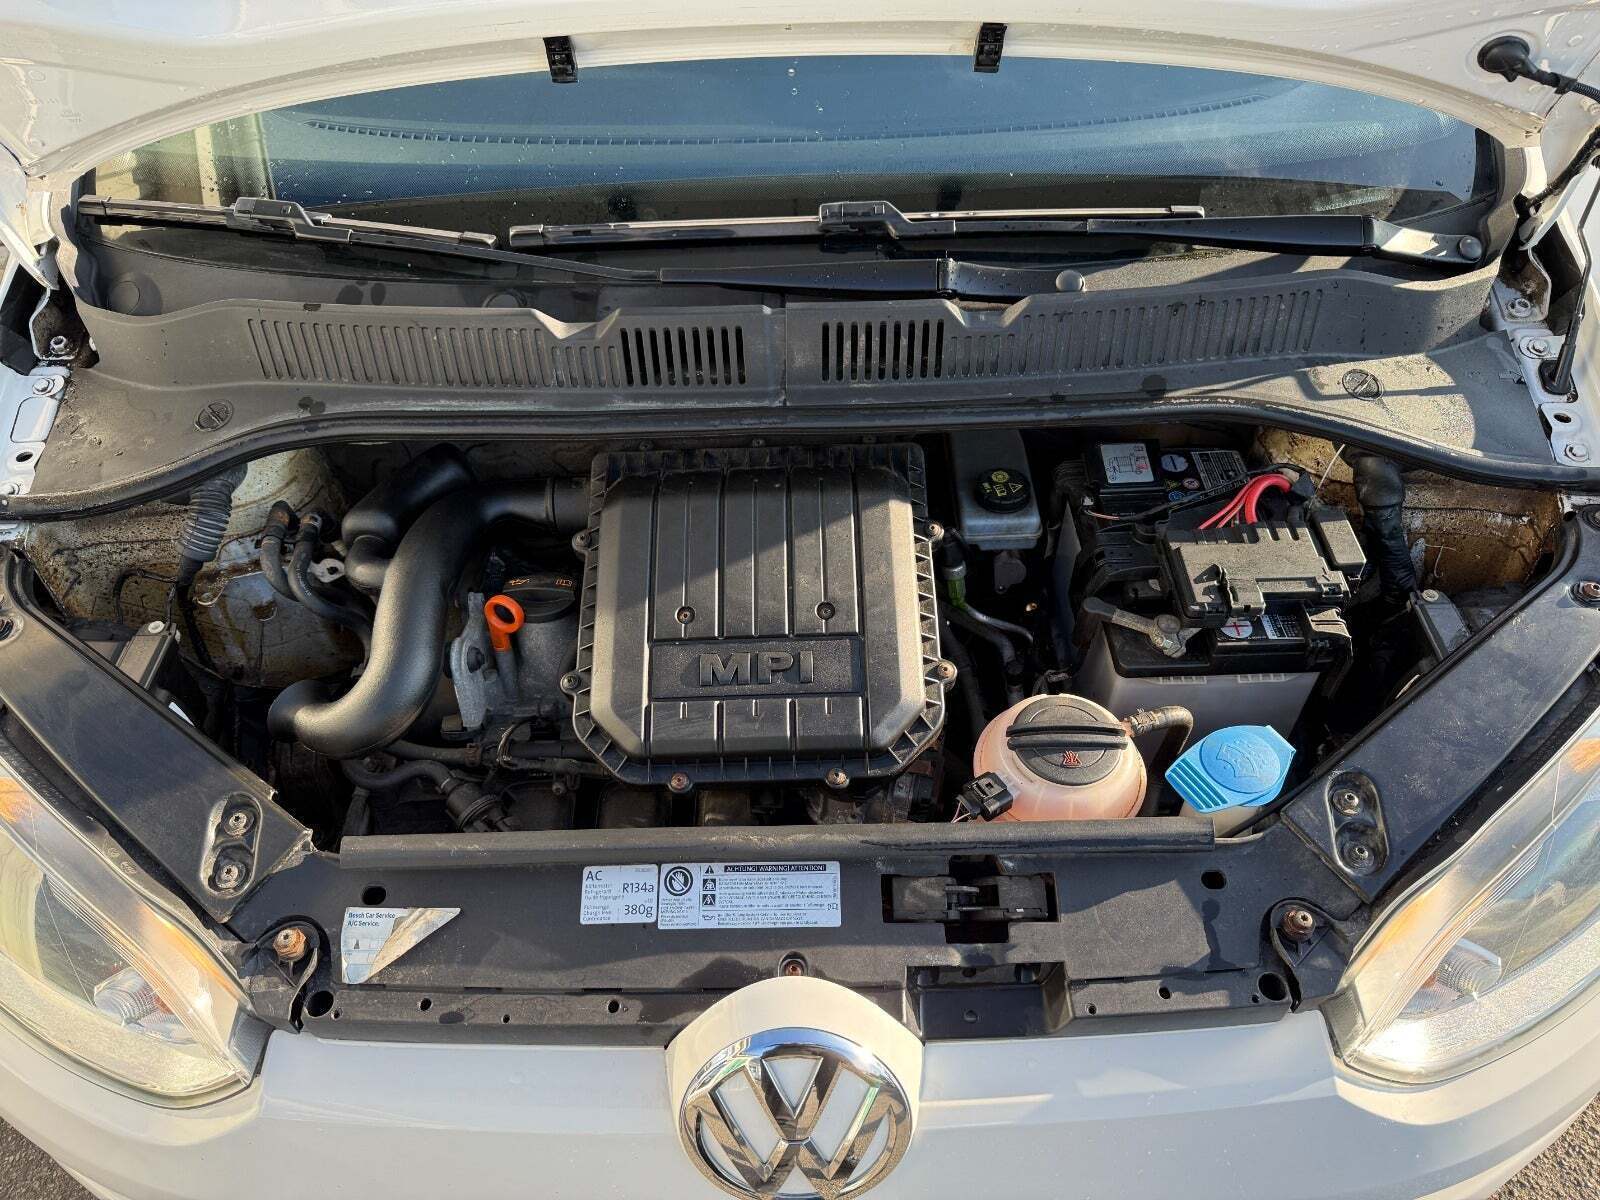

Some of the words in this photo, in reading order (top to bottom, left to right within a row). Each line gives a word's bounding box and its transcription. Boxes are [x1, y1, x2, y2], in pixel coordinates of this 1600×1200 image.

[699, 650, 815, 687] MPI
[585, 870, 603, 882] AC
[622, 881, 655, 894] R134a
[624, 903, 654, 919] 380g
